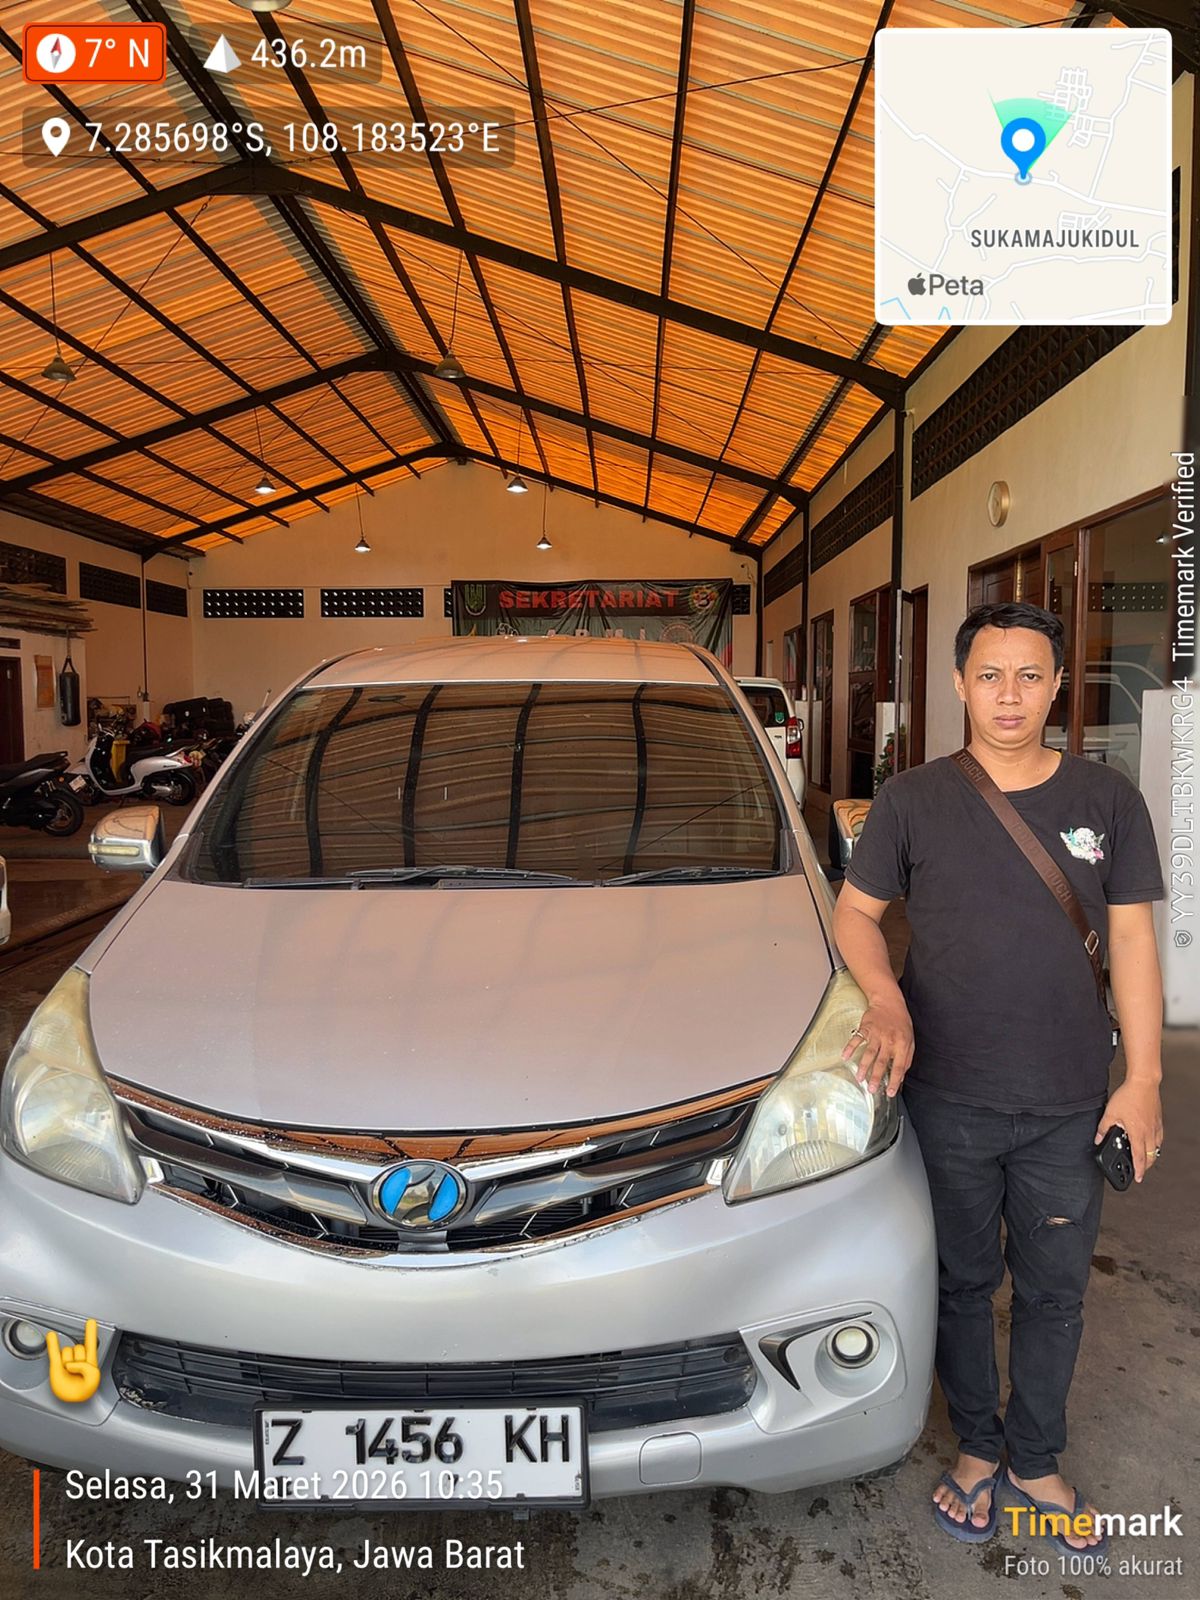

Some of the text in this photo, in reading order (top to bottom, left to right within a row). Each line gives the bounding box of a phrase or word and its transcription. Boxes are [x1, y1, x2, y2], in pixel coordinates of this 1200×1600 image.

[499, 589, 679, 609] SEKRETARIAT
[956, 751, 985, 782] TOUCH
[271, 1418, 306, 1467] Z
[345, 1416, 464, 1466] 1456
[503, 1414, 571, 1464] KH
